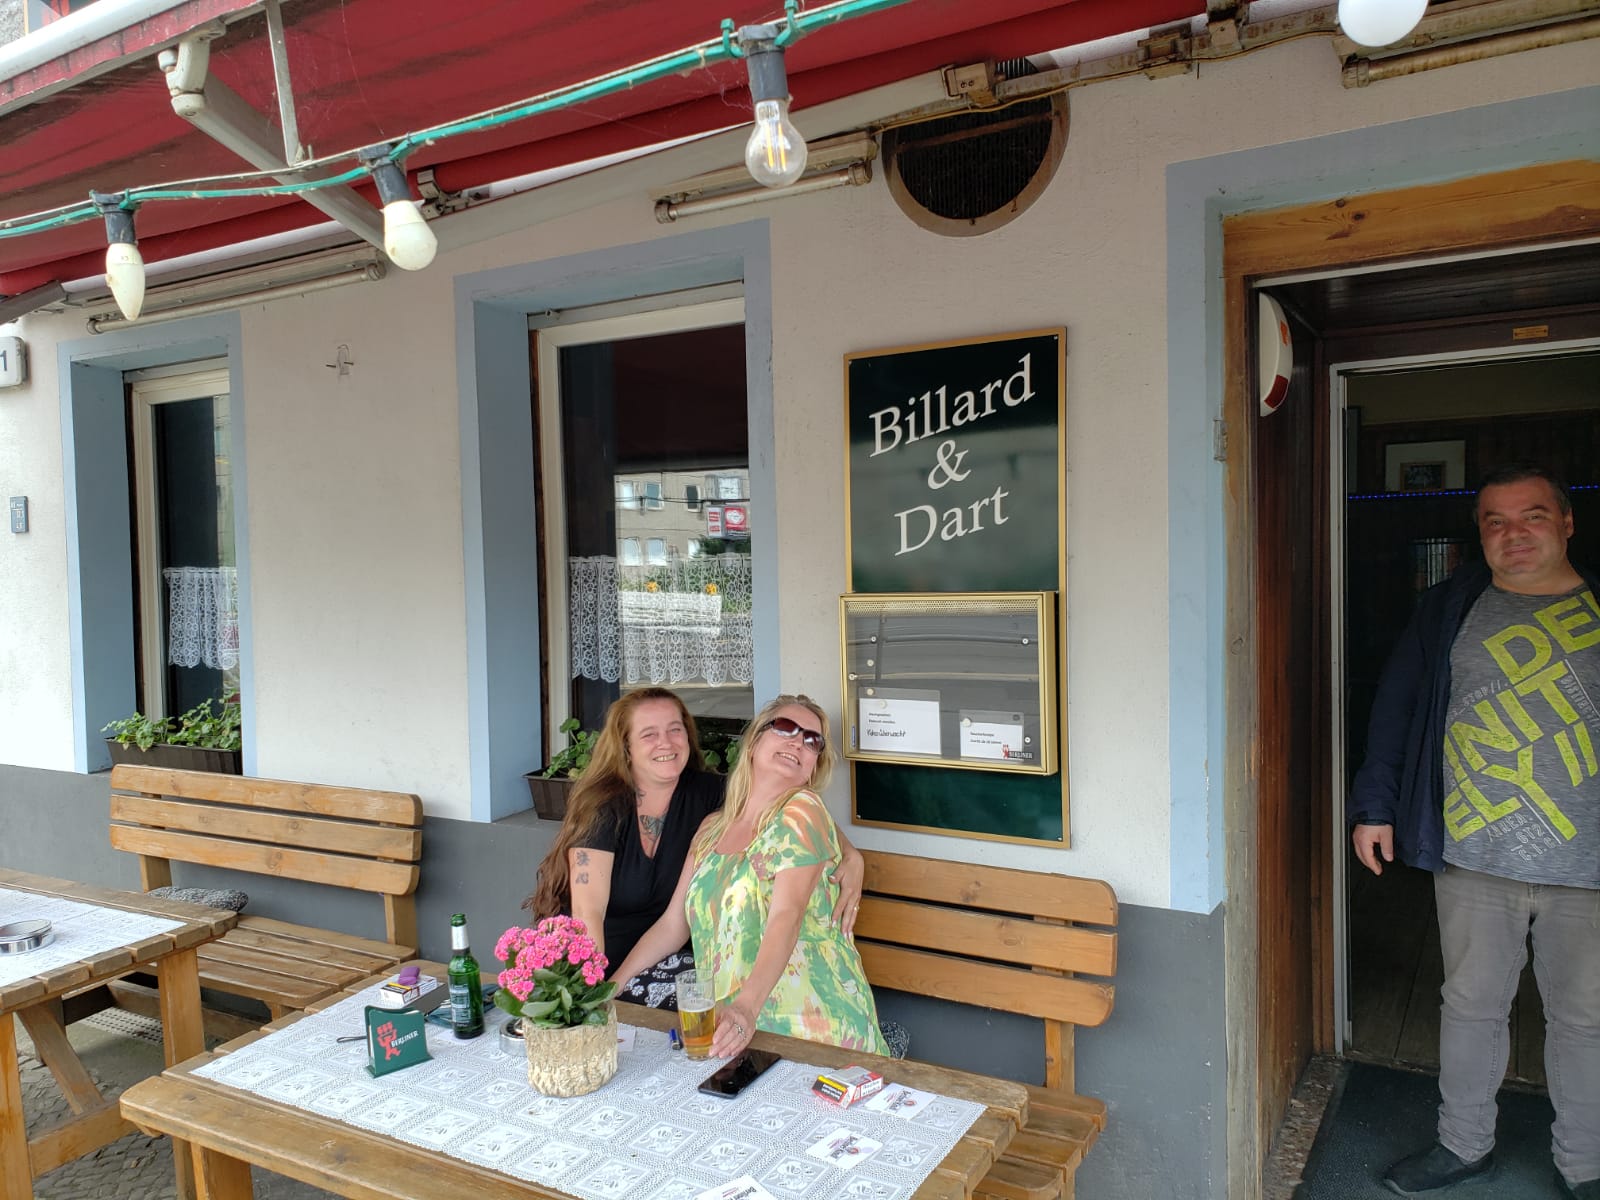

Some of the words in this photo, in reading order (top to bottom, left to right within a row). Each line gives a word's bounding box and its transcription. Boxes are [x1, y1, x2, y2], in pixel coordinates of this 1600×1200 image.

[868, 352, 1036, 458] Billard
[927, 439, 972, 490] &
[893, 485, 1010, 557] Dart
[391, 1030, 419, 1048] BERLINER
